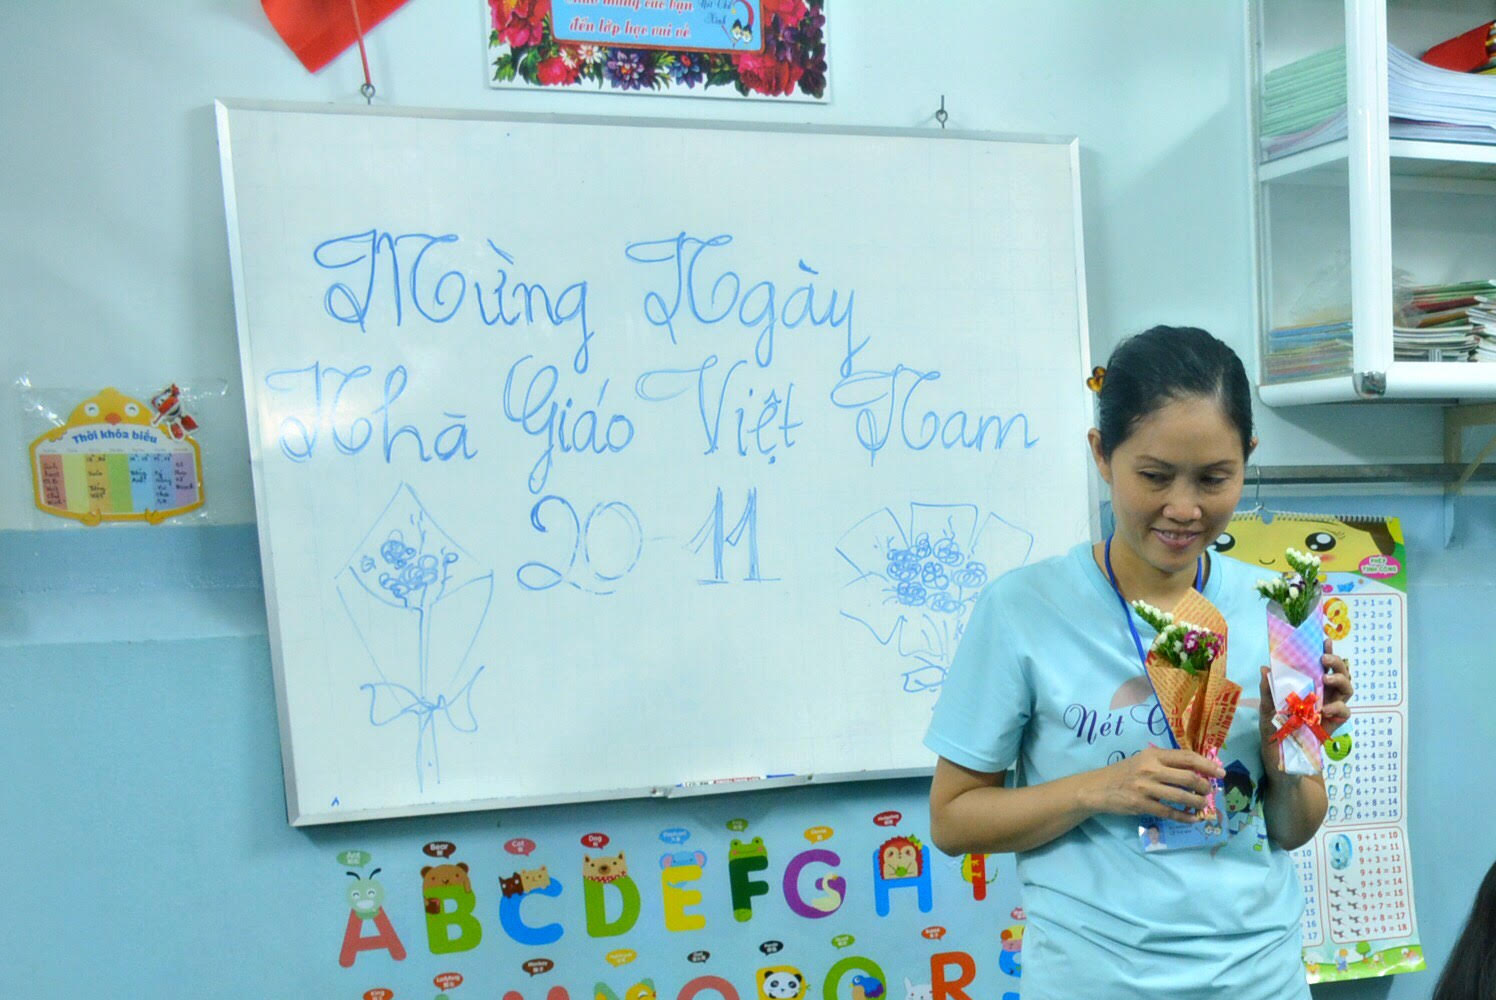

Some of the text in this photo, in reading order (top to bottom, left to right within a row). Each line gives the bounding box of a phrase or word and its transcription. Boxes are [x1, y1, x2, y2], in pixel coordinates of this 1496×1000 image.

[599, 18, 621, 36] lớp
[624, 20, 648, 38] học
[314, 229, 871, 374] Mừng Ngày
[72, 428, 158, 444] Thời khóa biểu
[503, 355, 635, 494] Giáo
[636, 355, 803, 465] Việt
[831, 364, 1040, 468] Nam
[1063, 703, 1124, 745] Nét
[429, 843, 449, 851] Bear
[588, 834, 602, 843] Dog
[339, 890, 407, 968] A
[423, 880, 482, 955] B
[499, 877, 563, 946] C
[583, 872, 641, 938] D
[661, 864, 706, 932] E
[729, 855, 769, 923] F
[783, 849, 846, 919] G
[872, 844, 933, 917] H
